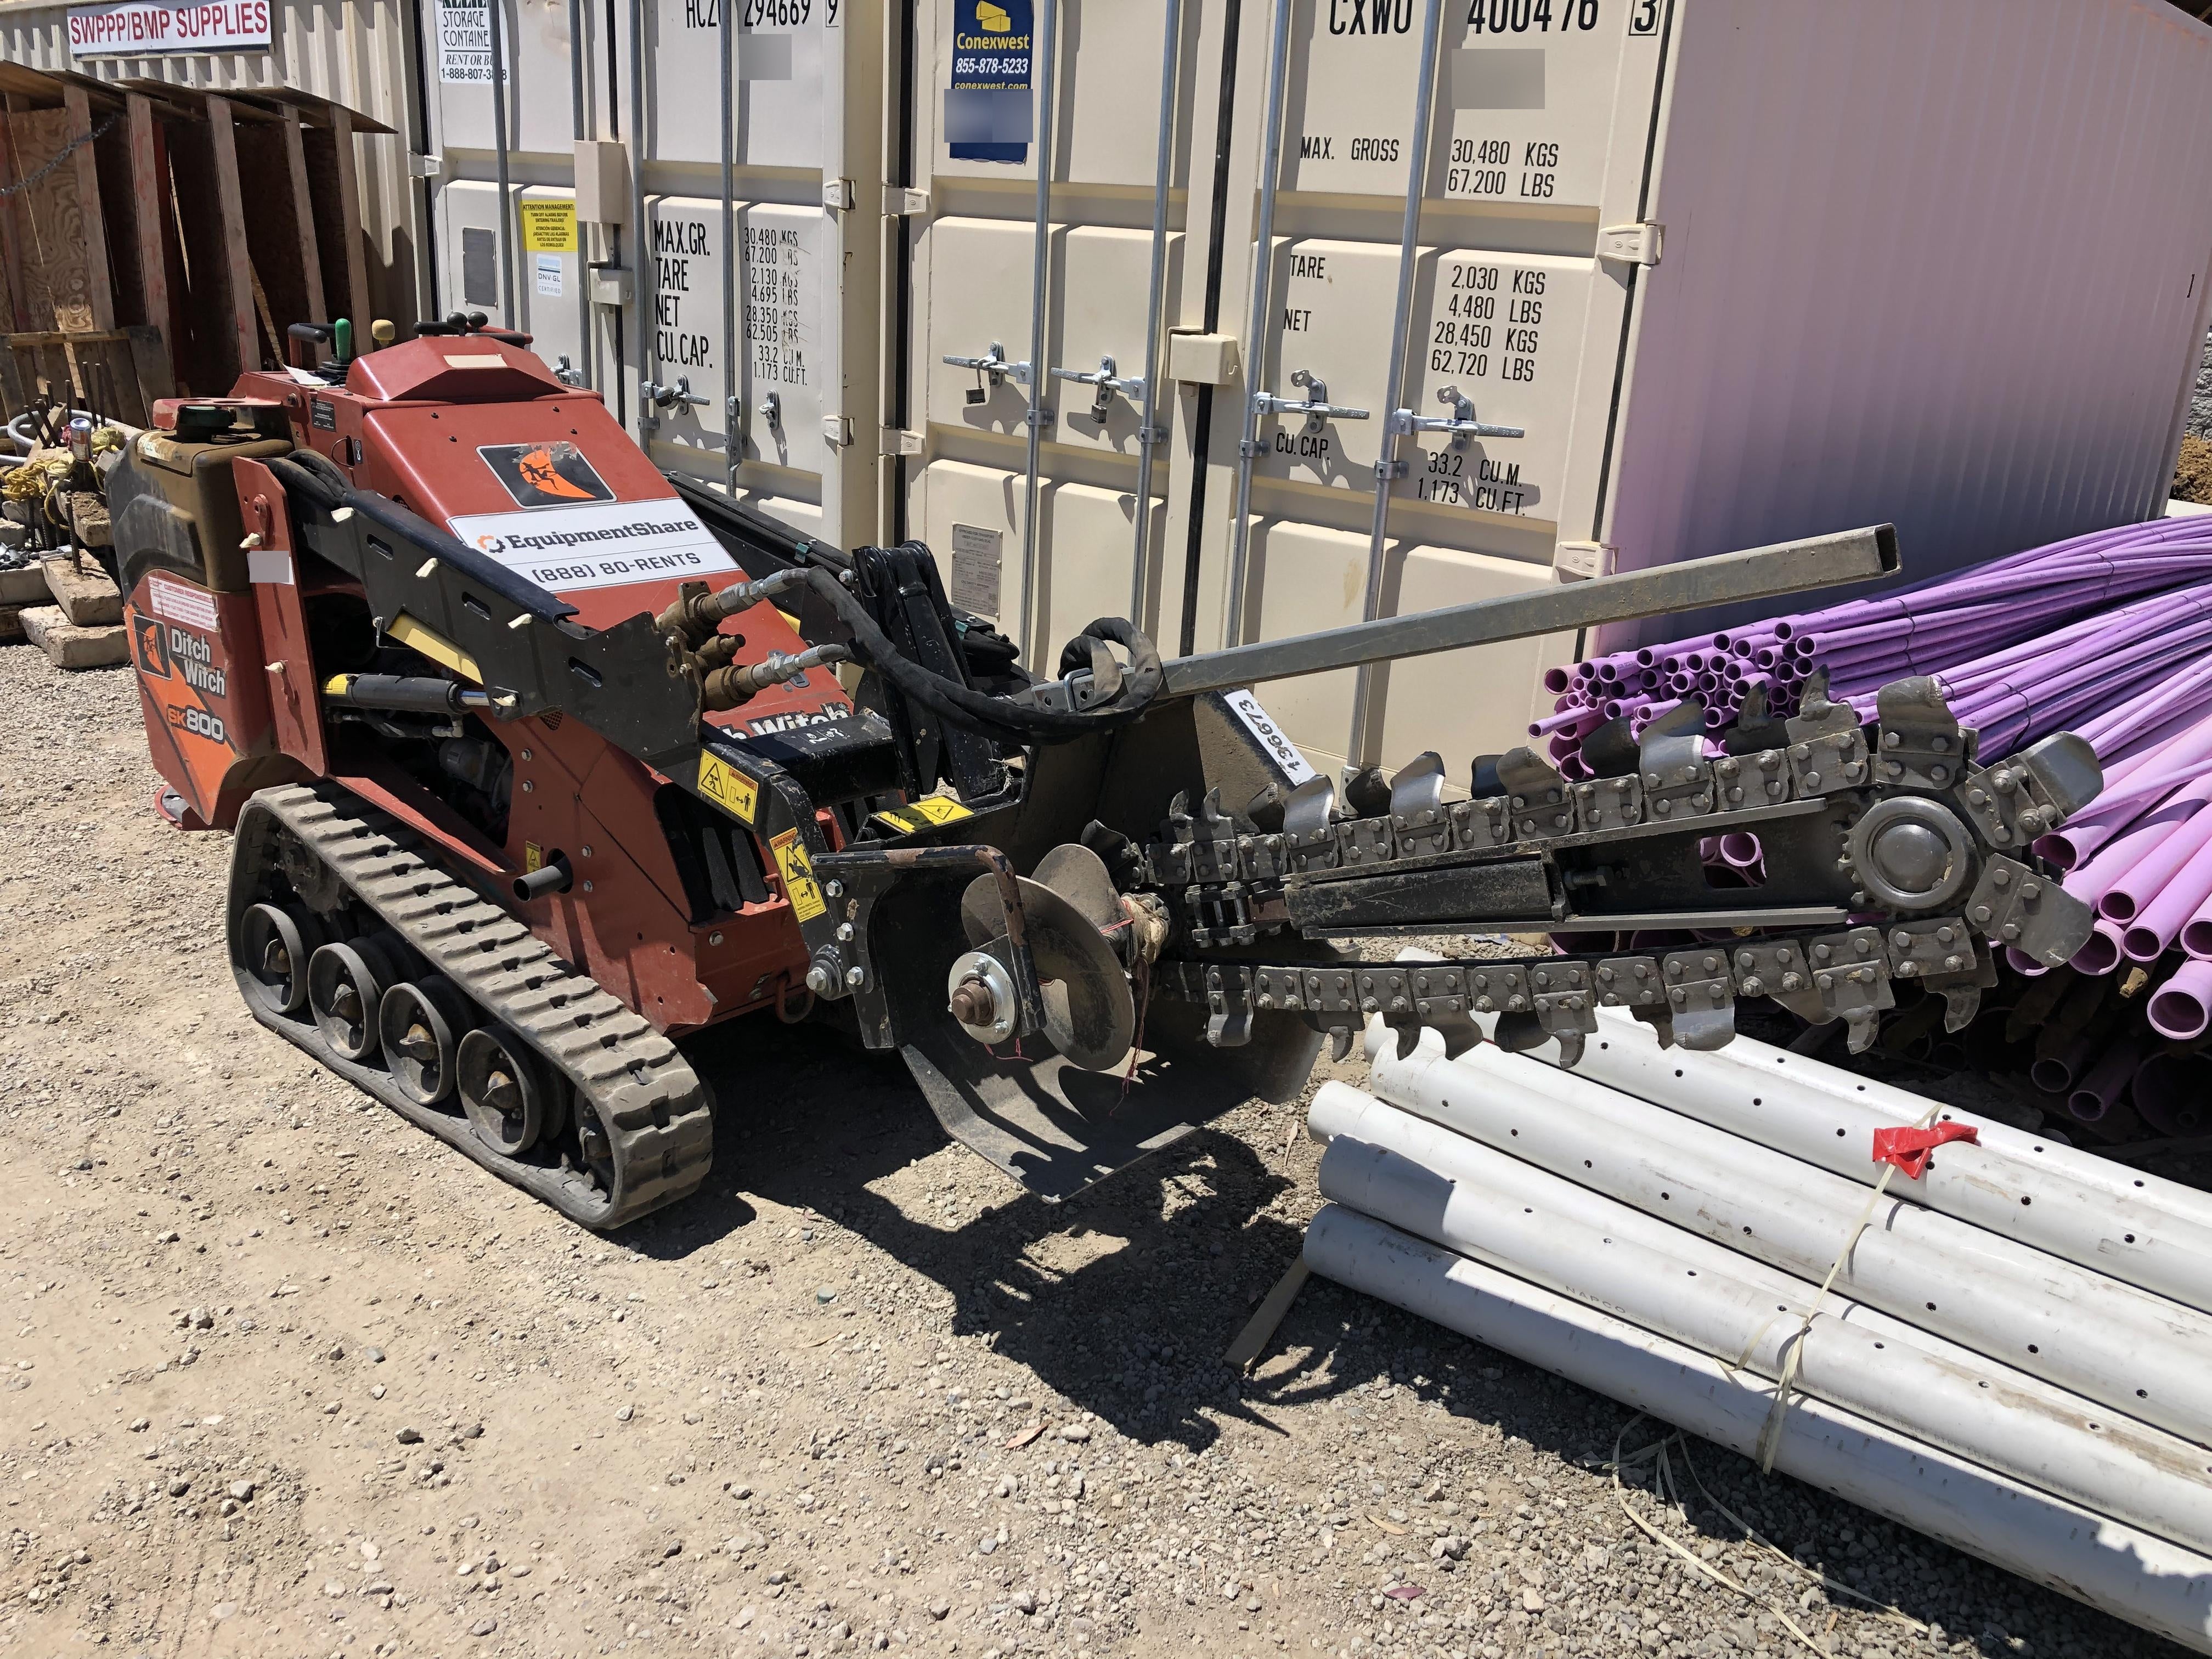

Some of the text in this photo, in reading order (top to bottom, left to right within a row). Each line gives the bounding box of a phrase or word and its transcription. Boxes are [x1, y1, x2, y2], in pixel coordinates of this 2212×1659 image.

[70, 1, 268, 44] SWPPP/BMP SUPPLIES
[443, 11, 485, 27] STORAGE
[444, 30, 490, 47] CONTAINE
[956, 32, 1029, 50] Conexwest
[441, 67, 507, 81] 1-888-807-38
[445, 54, 469, 65] RENT
[470, 54, 482, 65] OR
[956, 58, 1028, 74] 855-878-5233
[955, 81, 1028, 89] conexwest.com
[1300, 137, 1559, 168] MAX. GROSS 30,480 KGS
[1448, 168, 1554, 198] 67,200 LBS
[654, 219, 798, 256] MAX.GR. 30,480 KGS
[744, 245, 777, 264] 67,200
[538, 273, 560, 283] DNV GL
[656, 257, 689, 291] TARE
[751, 268, 777, 287] 2,130
[1290, 254, 1546, 295] TARE 2,030 KGS
[538, 285, 561, 295] CERTIFIED
[751, 287, 777, 304] 4,695
[656, 294, 680, 327] NET
[746, 305, 778, 325] 28,350
[1448, 294, 1542, 325] 4,480 LBS
[746, 325, 778, 342] 62,505
[1283, 308, 1538, 354] NET 28,450 KGS
[759, 345, 778, 364] 33.2
[1431, 349, 1534, 382] 62,720 LBS
[754, 362, 808, 386] 1,173 CU.FT.
[1427, 452, 1463, 478] 33.2
[1479, 459, 1522, 488] CU.M.
[1417, 477, 1526, 517] 1,173 CU.FT.
[506, 519, 699, 550] EquipmentShare
[532, 552, 701, 583] (888) 80-RENTS
[172, 628, 211, 663] Ditch
[184, 659, 226, 696] Witch
[167, 707, 224, 742] SK800
[1565, 1285, 1626, 1313] NAPCO
[1602, 1317, 1666, 1344] NAPCO
